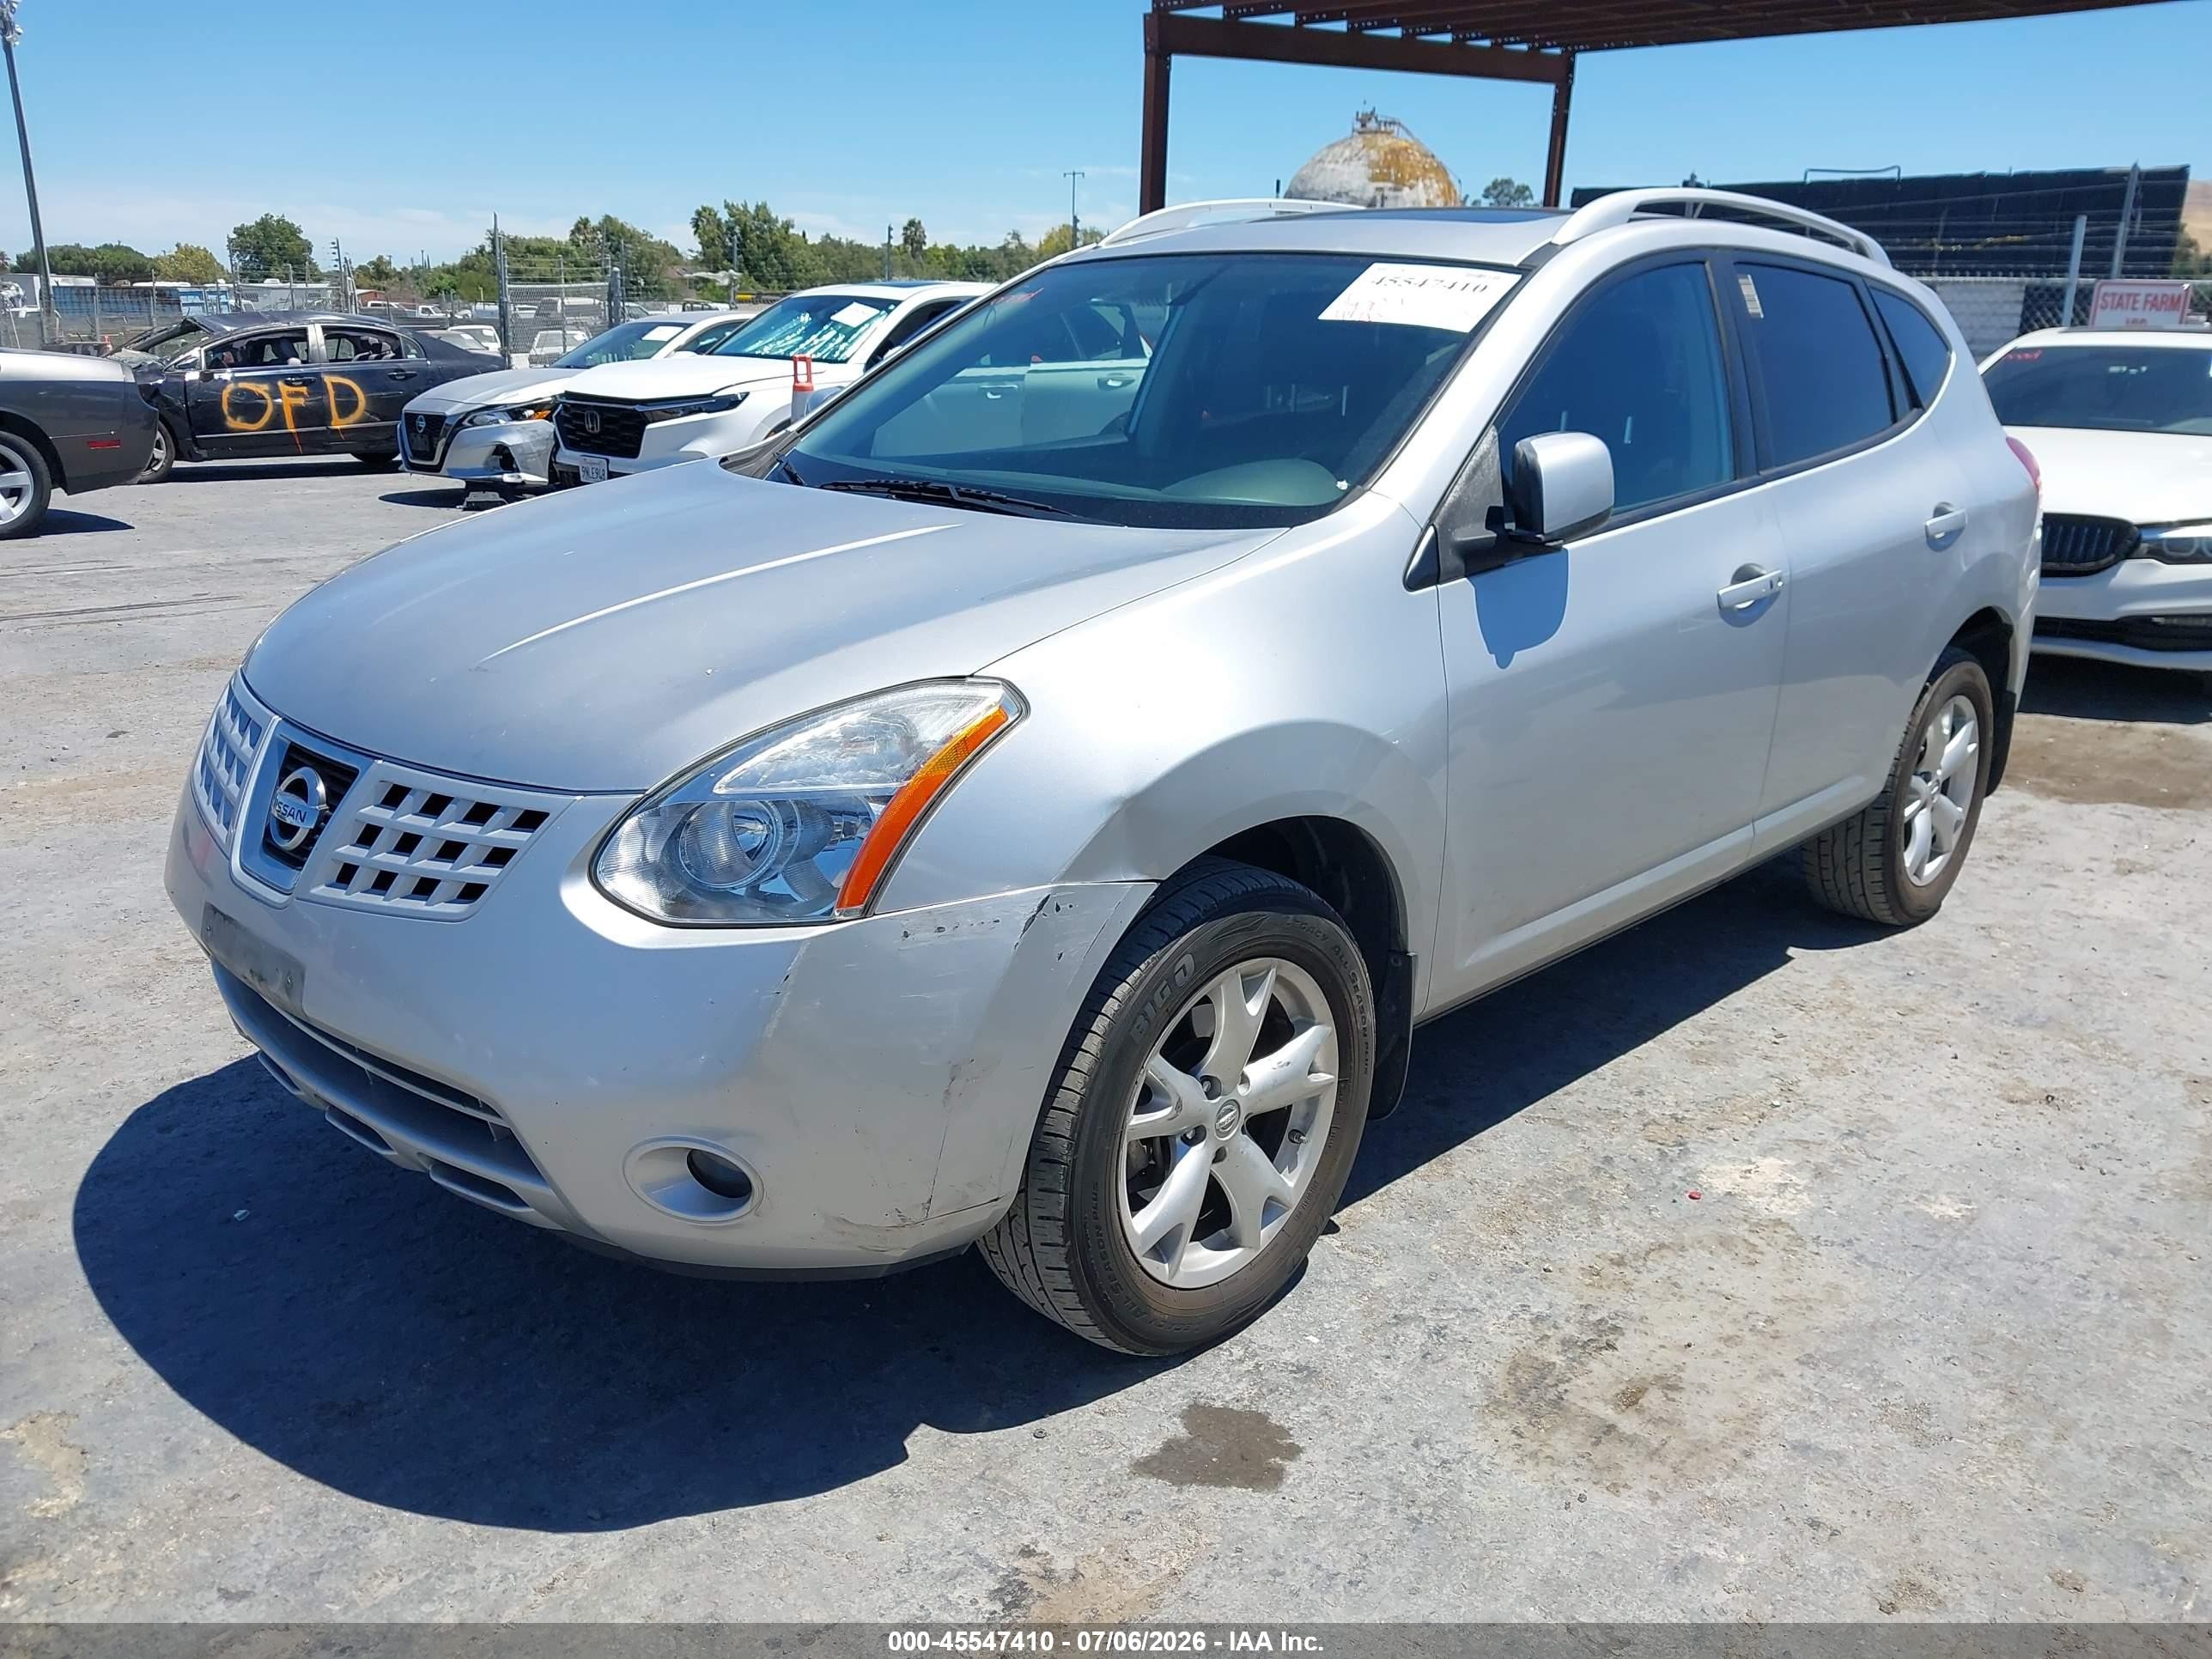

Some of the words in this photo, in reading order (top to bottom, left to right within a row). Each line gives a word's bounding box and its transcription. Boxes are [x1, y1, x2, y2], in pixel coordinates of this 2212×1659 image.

[1371, 276, 1489, 294] 45547410
[2100, 292, 2140, 310] STATE
[2142, 292, 2182, 311] FARM
[222, 374, 367, 440] OFD
[275, 799, 307, 823] ISSAN
[1284, 915, 1329, 944] LEGACY
[1332, 945, 1350, 970] ALL
[1348, 971, 1369, 1039] SEASON
[1093, 1224, 1124, 1296] SEASON
